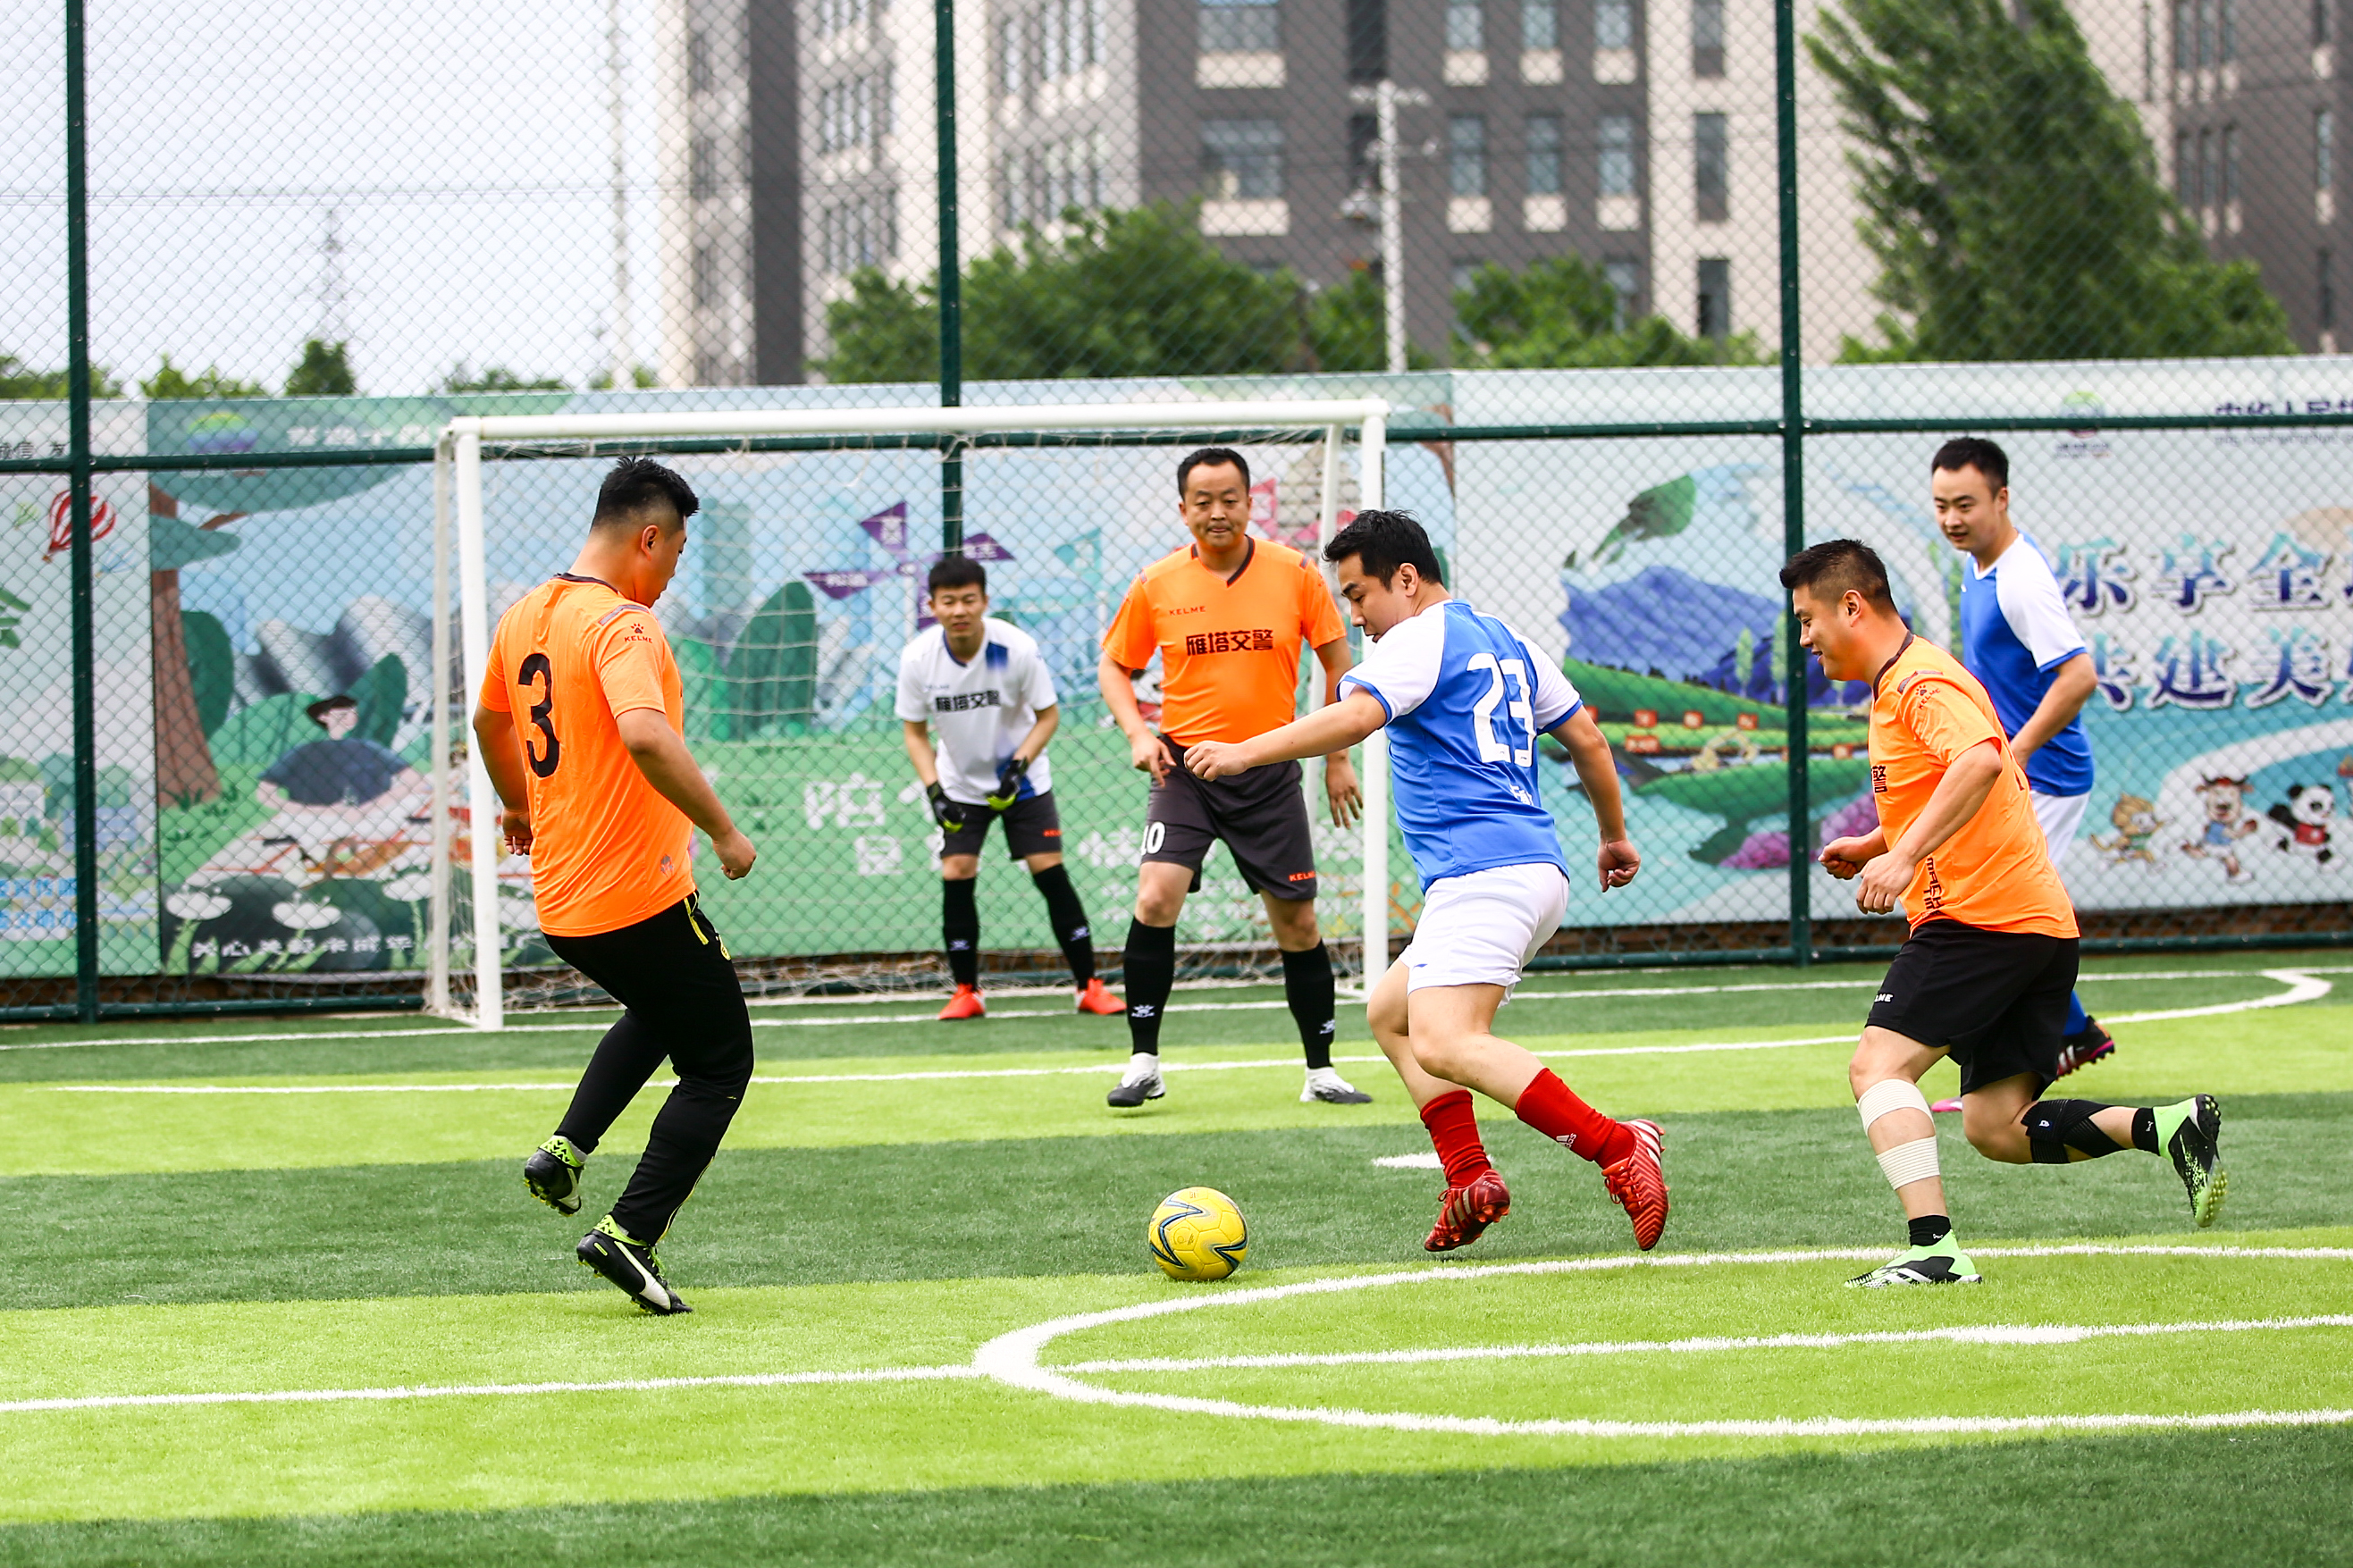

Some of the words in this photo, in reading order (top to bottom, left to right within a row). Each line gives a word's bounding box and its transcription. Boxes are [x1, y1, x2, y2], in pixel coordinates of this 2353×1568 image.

[2054, 532, 2353, 614] 乐享全
[1169, 606, 1206, 616] KELME
[624, 635, 653, 644] KELME
[1186, 629, 1273, 657] 雁塔交警
[2082, 628, 2353, 710] 共建美
[518, 653, 560, 778] 3
[936, 690, 1000, 712] 雁塔交警
[1466, 653, 1537, 768] 23
